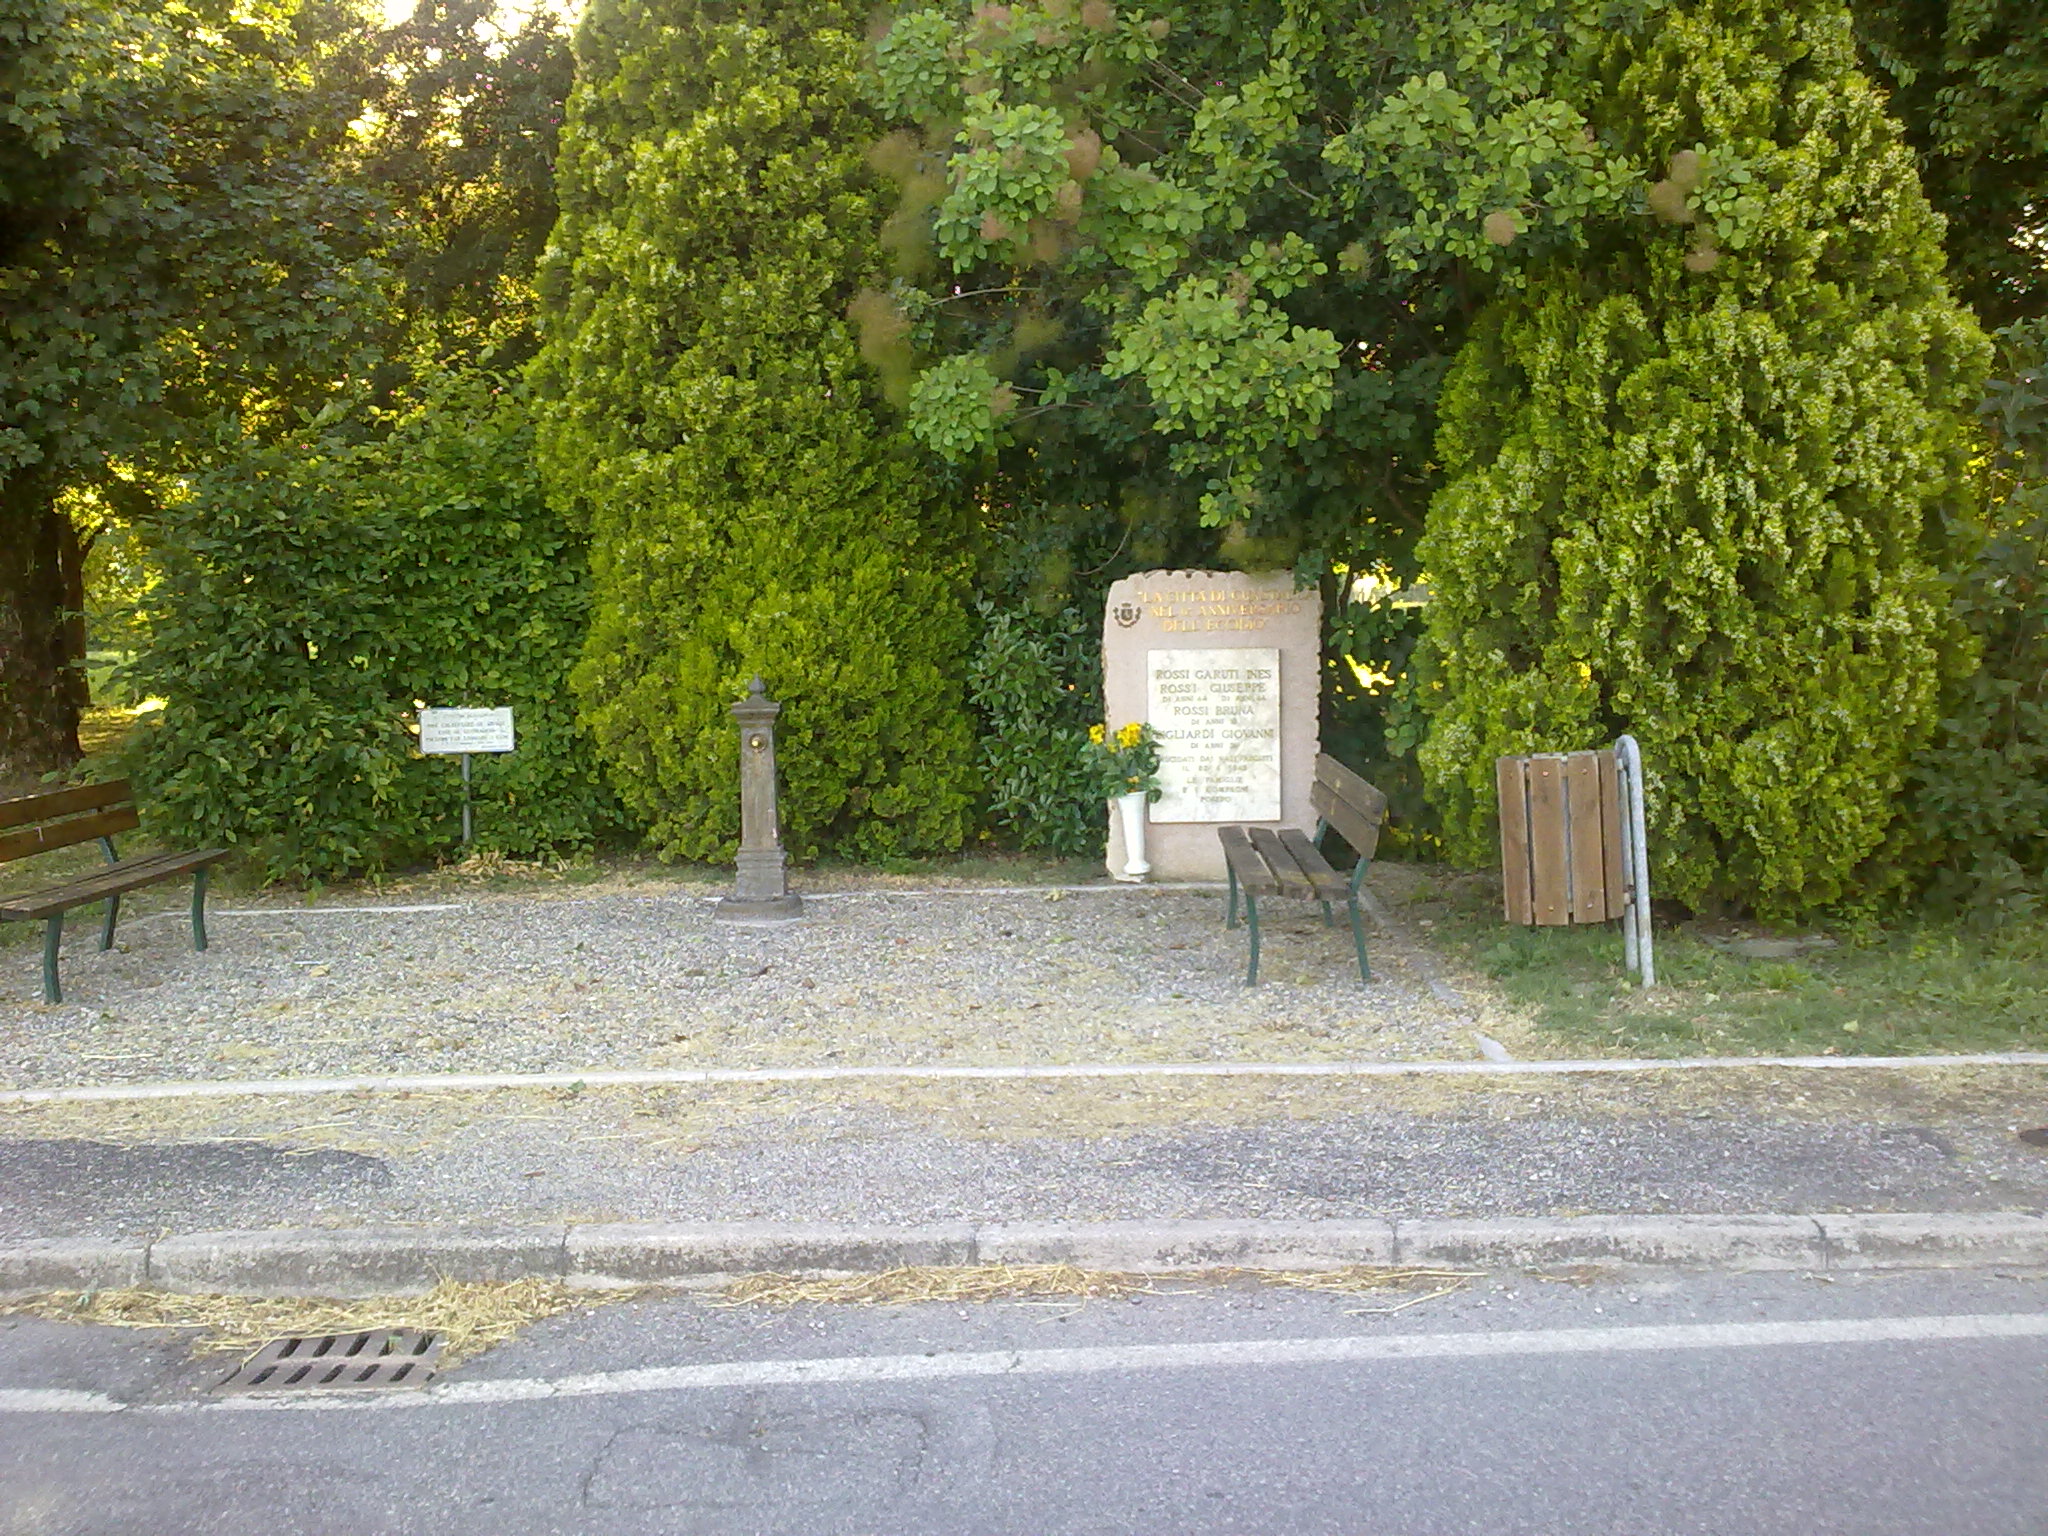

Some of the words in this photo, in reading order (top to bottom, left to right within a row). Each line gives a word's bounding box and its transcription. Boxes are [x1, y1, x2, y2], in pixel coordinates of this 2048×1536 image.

[1151, 606, 1176, 618] NEL
[1156, 668, 1190, 680] ROSSI
[1195, 668, 1239, 680] GARUTI
[1247, 668, 1272, 680] INES
[1160, 684, 1197, 694] ROSSI
[1210, 682, 1266, 694] GIUSEPPE
[1174, 706, 1208, 716] ROSSI
[1215, 706, 1255, 716] BRUNA
[1222, 729, 1274, 740] GIOVANNI
